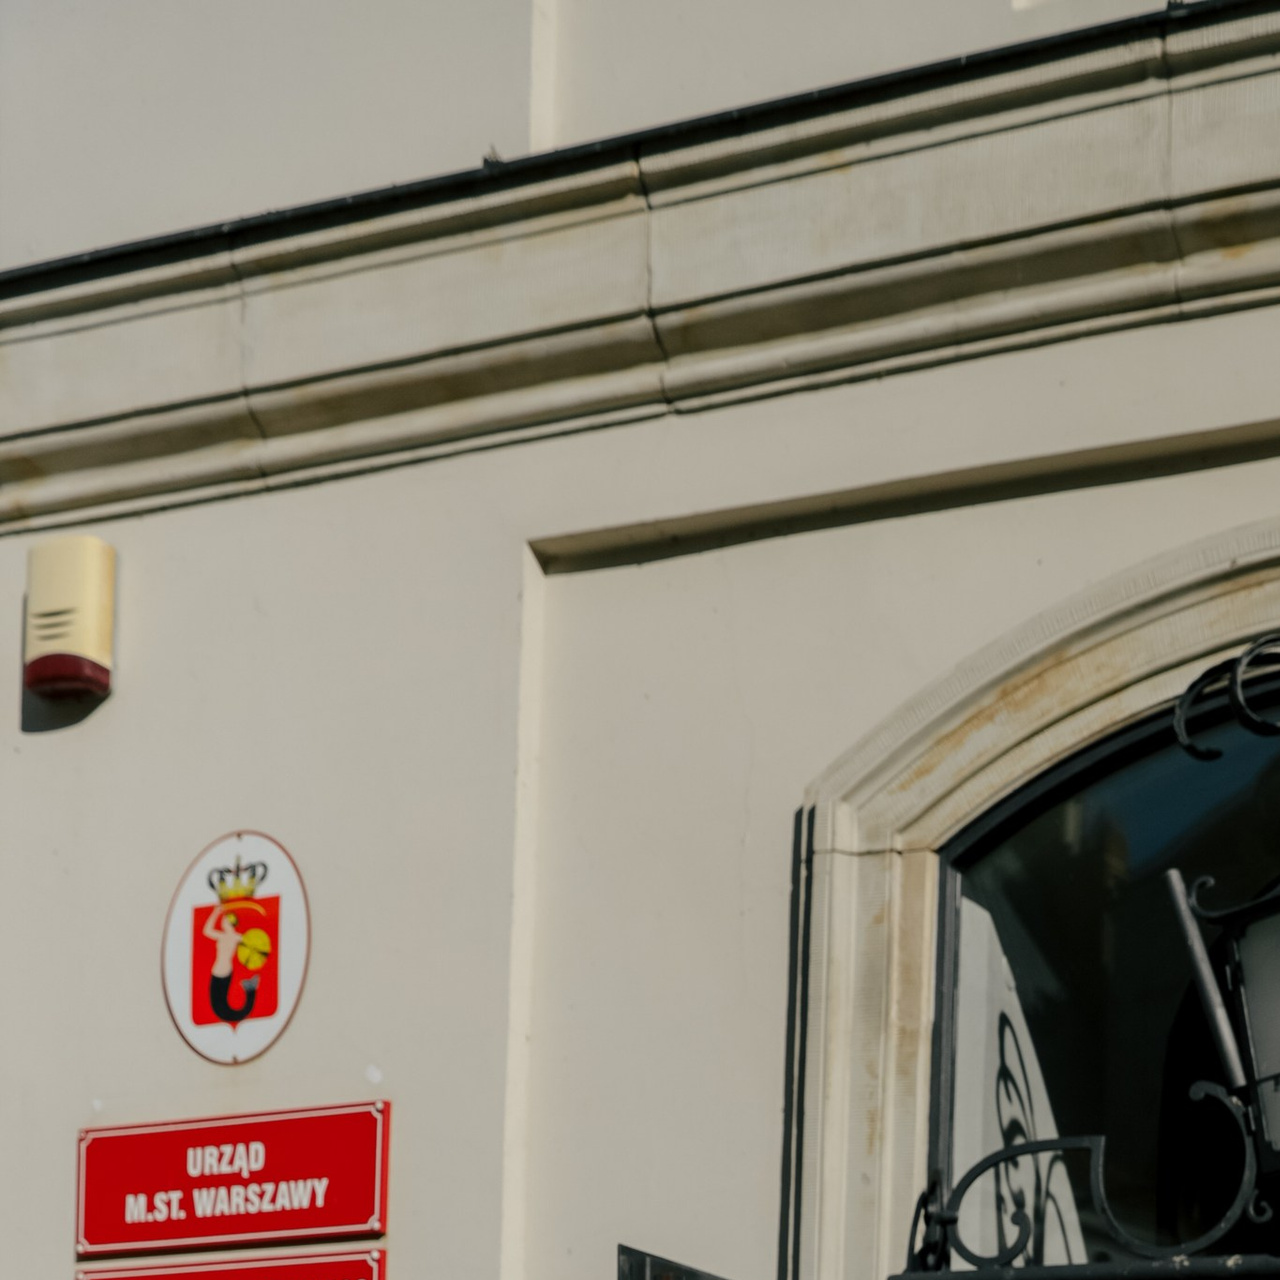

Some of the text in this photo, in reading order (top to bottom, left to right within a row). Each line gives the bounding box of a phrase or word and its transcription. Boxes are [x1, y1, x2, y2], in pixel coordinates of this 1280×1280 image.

[187, 1142, 265, 1178] URZĄD
[125, 1177, 329, 1223] M.ST. WARSZAWY
